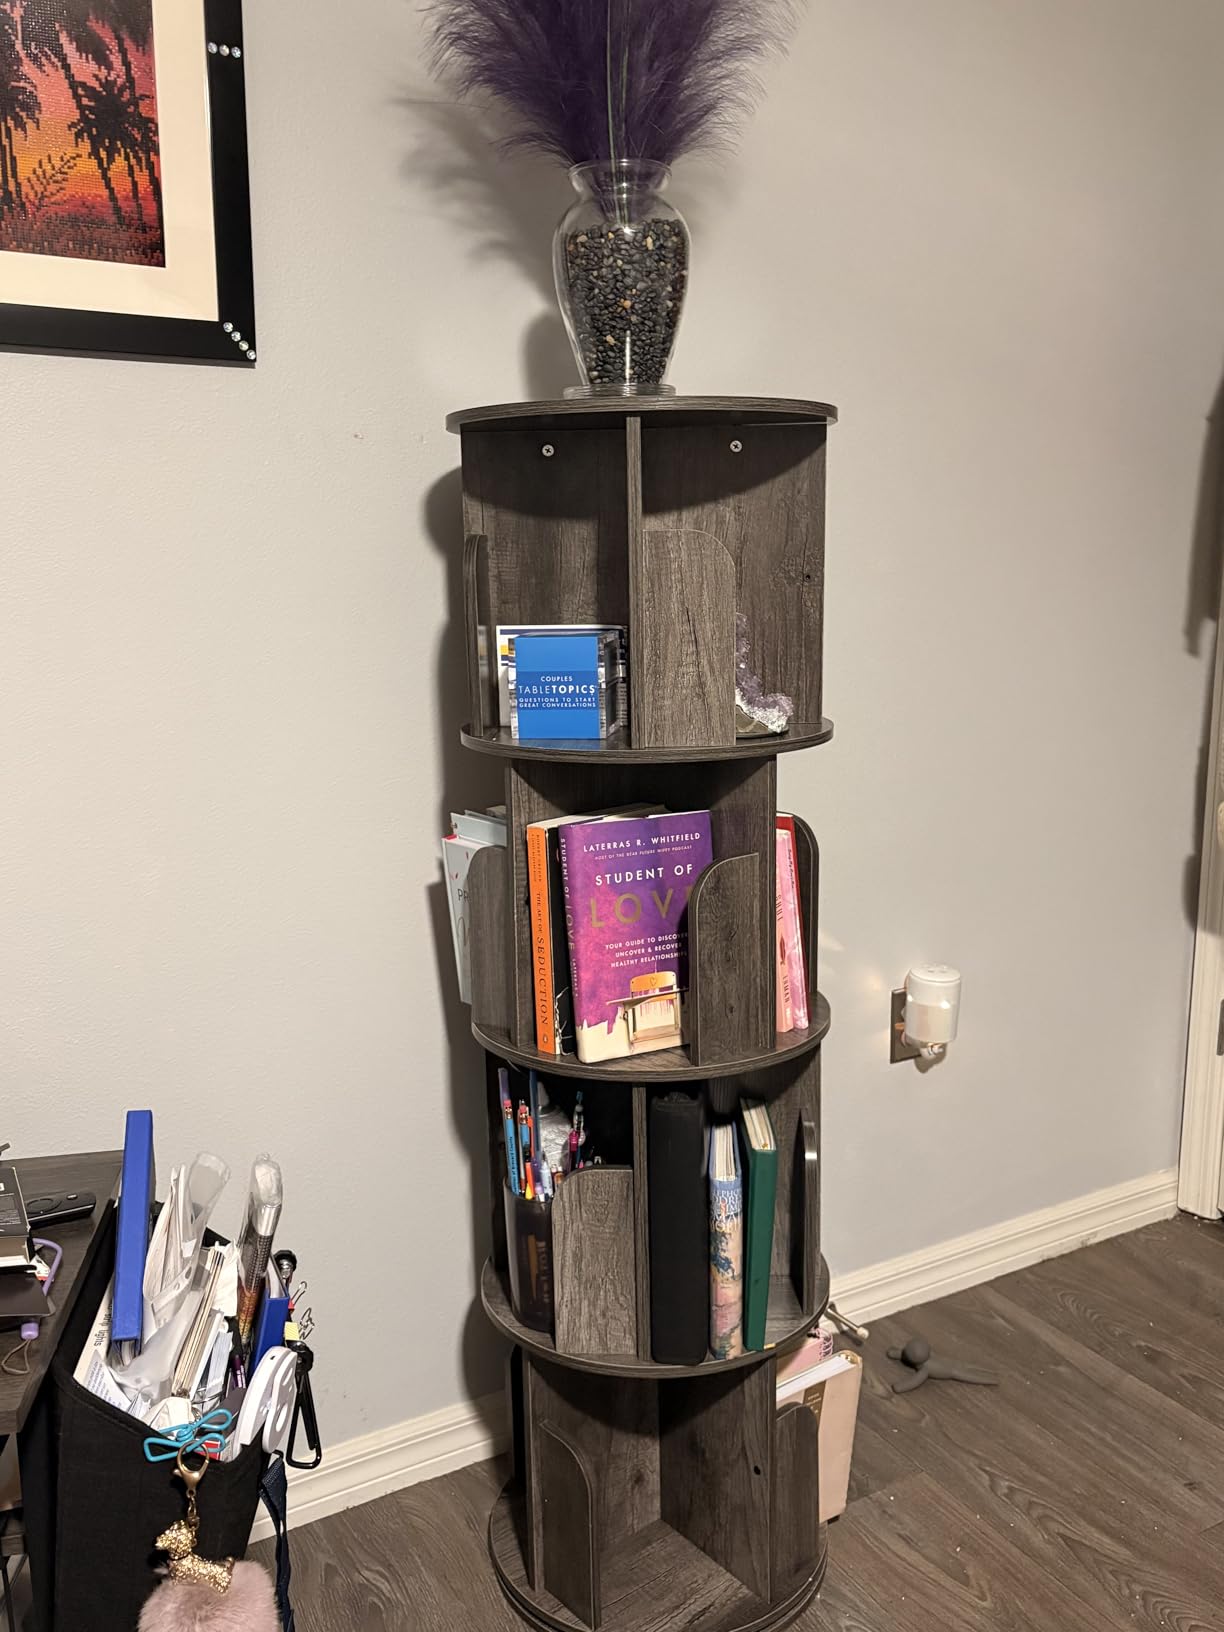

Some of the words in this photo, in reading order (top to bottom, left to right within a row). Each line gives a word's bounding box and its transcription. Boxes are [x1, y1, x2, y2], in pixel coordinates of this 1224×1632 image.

[518, 684, 596, 695] TABLETOPICS
[583, 840, 631, 852] LATERRAS
[636, 839, 646, 847] R.
[651, 832, 701, 845] WHITFIELD
[561, 838, 569, 881] STUDENT
[595, 867, 664, 886] STUDENT
[674, 863, 693, 876] OF
[564, 886, 570, 899] OF
[625, 939, 645, 947] GUIDE
[615, 948, 645, 958] UNCOVER
[610, 959, 638, 968] HEALTHY
[537, 936, 548, 1025] SEDUCTION
